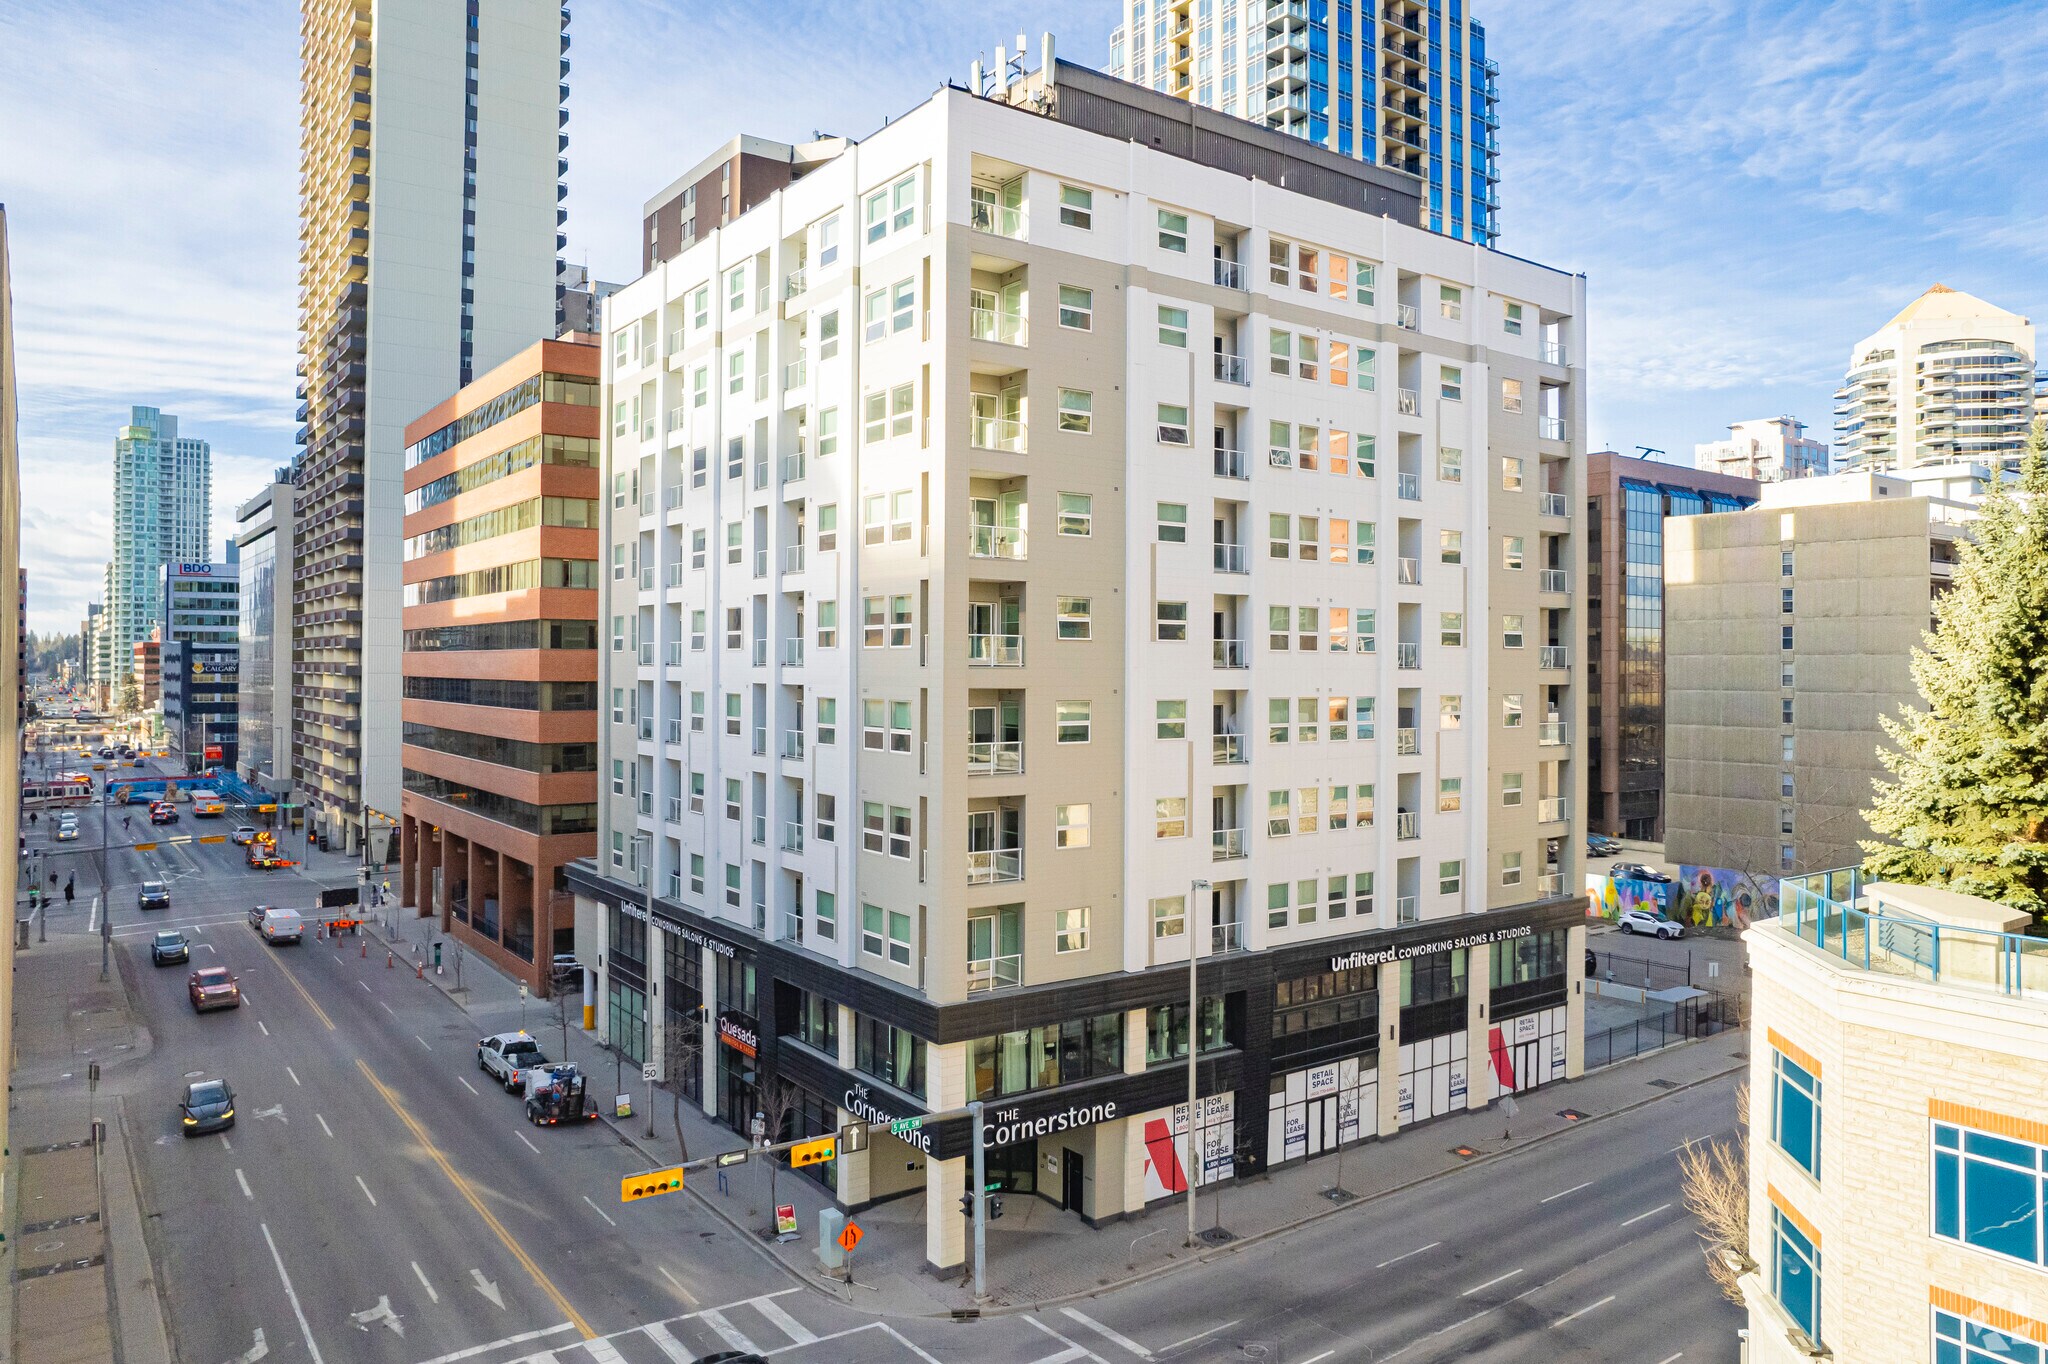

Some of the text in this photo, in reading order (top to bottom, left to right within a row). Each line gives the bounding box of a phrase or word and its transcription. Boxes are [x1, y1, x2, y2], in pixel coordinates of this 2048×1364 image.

[183, 563, 211, 573] BDO
[621, 900, 734, 958] Unfiltere COWORKING SALONS & STUDIOS
[1398, 941, 1453, 959] COWORKING
[1454, 933, 1487, 949] SALONS
[1489, 932, 1495, 942] &
[1497, 925, 1531, 940] STUDIOS
[1519, 1018, 1535, 1026] RETAIL
[720, 1017, 757, 1047] Quesada
[1519, 1024, 1535, 1033] SPACE
[644, 1069, 657, 1079] 50
[1311, 1069, 1334, 1081] RETAIL
[1450, 1073, 1461, 1081] FOR
[1312, 1077, 1334, 1089] SPACE
[1450, 1079, 1465, 1088] LEASE
[854, 1083, 868, 1100] THE
[1206, 1096, 1222, 1108] FOR
[1398, 1094, 1412, 1102] EASE
[1176, 1102, 1202, 1116] RETIL
[1206, 1103, 1229, 1116] LEASE
[997, 1108, 1019, 1123] THE
[893, 1119, 920, 1132] 5 AVE SW
[983, 1102, 1116, 1148] Cornerstone
[1286, 1118, 1299, 1128] FOR
[1286, 1124, 1304, 1135] LEASE
[1206, 1139, 1222, 1150] FOR
[1206, 1145, 1229, 1159] LEASE
